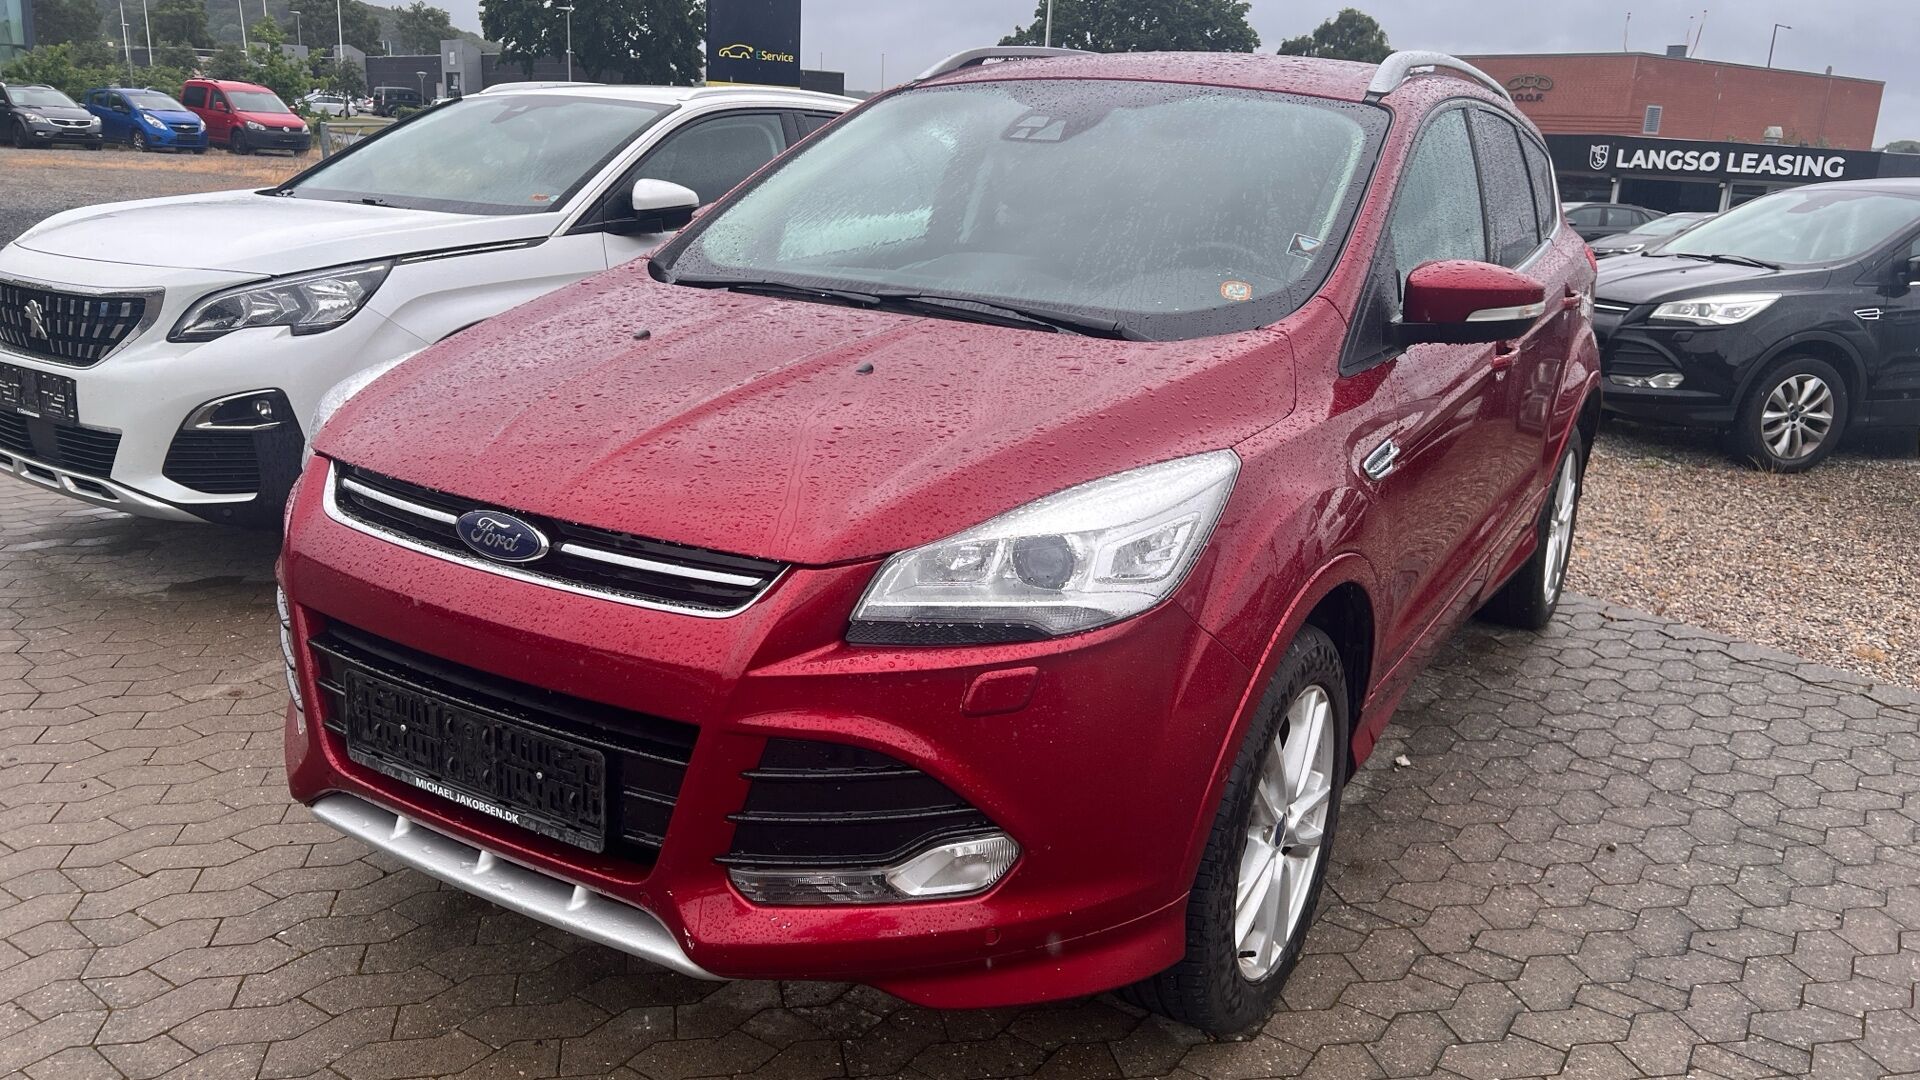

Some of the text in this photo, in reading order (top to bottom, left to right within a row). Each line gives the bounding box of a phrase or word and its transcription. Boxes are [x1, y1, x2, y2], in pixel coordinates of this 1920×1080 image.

[1615, 149, 1846, 178] LANGSØ LEASING
[470, 516, 522, 552] Ford
[415, 777, 519, 824] MICHAEL JAKOBSEN.DK
